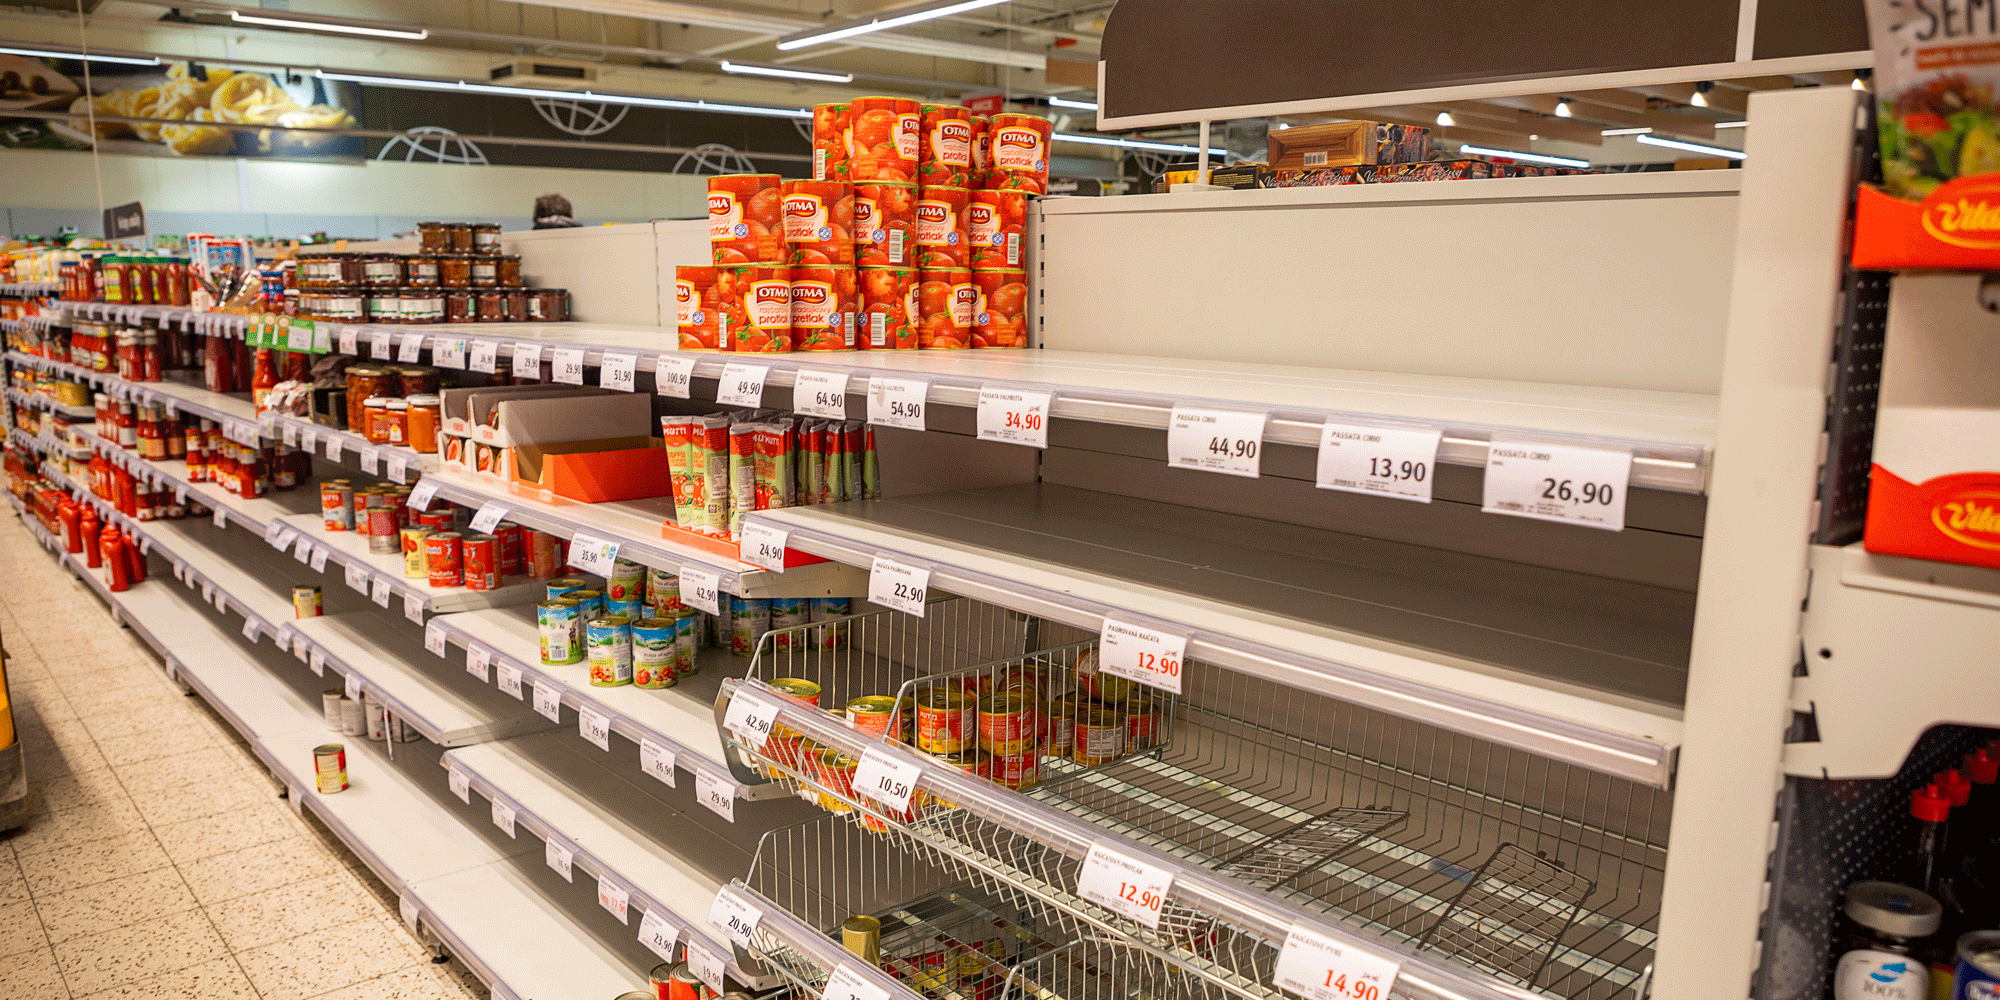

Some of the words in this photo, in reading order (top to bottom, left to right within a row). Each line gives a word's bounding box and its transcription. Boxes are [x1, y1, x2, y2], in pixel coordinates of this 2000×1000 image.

[1002, 133, 1034, 144] OTMA
[1000, 156, 1032, 166] protlak
[793, 288, 825, 298] OTMA
[566, 363, 581, 375] 29,90
[614, 369, 632, 383] 51,90
[667, 372, 687, 385] 100,90
[737, 381, 761, 395] 49,90
[981, 392, 999, 400] PASSATA
[816, 391, 843, 408] 64,90
[891, 401, 921, 418] 54,90
[1177, 414, 1201, 422] PASSATA
[1005, 411, 1041, 431] 34,90
[1331, 431, 1361, 441] PASSATA
[1362, 435, 1381, 443] CIRIO
[1209, 437, 1257, 459] 44,90
[1493, 449, 1527, 459] PASSATA
[1529, 452, 1551, 461] CIRIO
[1370, 457, 1426, 482] 13,90
[1542, 477, 1613, 506] 26,90
[759, 543, 782, 560] 24,90
[696, 587, 716, 602] 42,90
[894, 582, 924, 603] 22,90
[1138, 652, 1179, 677] 12,90
[745, 713, 769, 734] 42,90
[592, 725, 606, 741] 29,90
[655, 759, 673, 778] 26,90
[879, 776, 908, 799] 10,50
[711, 790, 730, 811] 29,90
[1118, 882, 1161, 912] 12,90
[728, 915, 752, 938] 20,90
[653, 932, 672, 953] 23,90
[703, 965, 721, 986] 19,90
[1324, 969, 1379, 1000] 14,90
